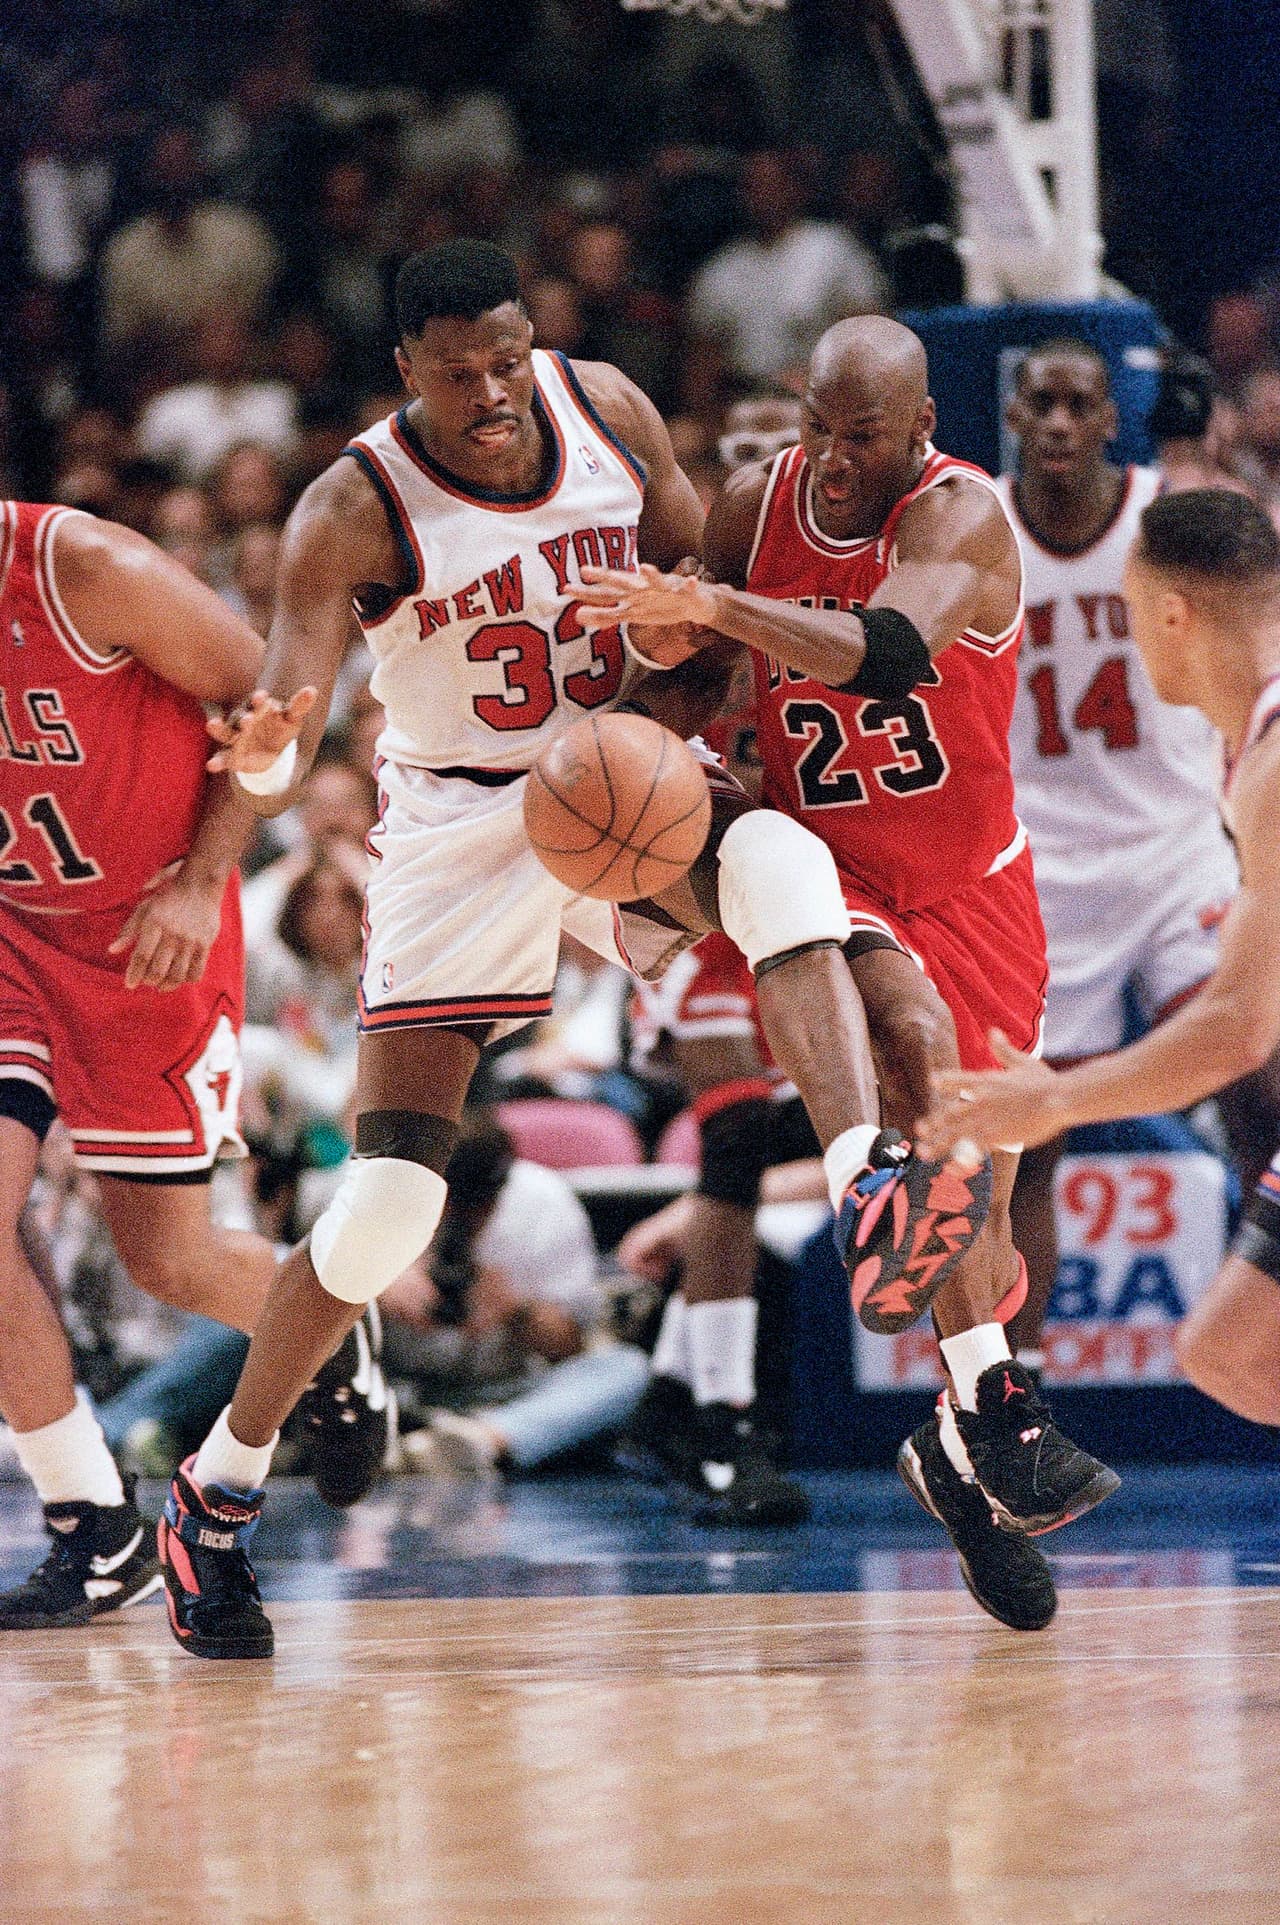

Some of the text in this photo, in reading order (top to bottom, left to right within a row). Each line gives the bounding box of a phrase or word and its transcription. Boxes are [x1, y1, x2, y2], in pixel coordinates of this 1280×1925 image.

[413, 554, 524, 641] NEW
[1075, 593, 1130, 641] YO
[466, 603, 627, 732] 33
[1028, 656, 1141, 757] 14
[781, 694, 950, 810] 23
[1064, 1166, 1180, 1245] 93
[1046, 1254, 1190, 1321] BA
